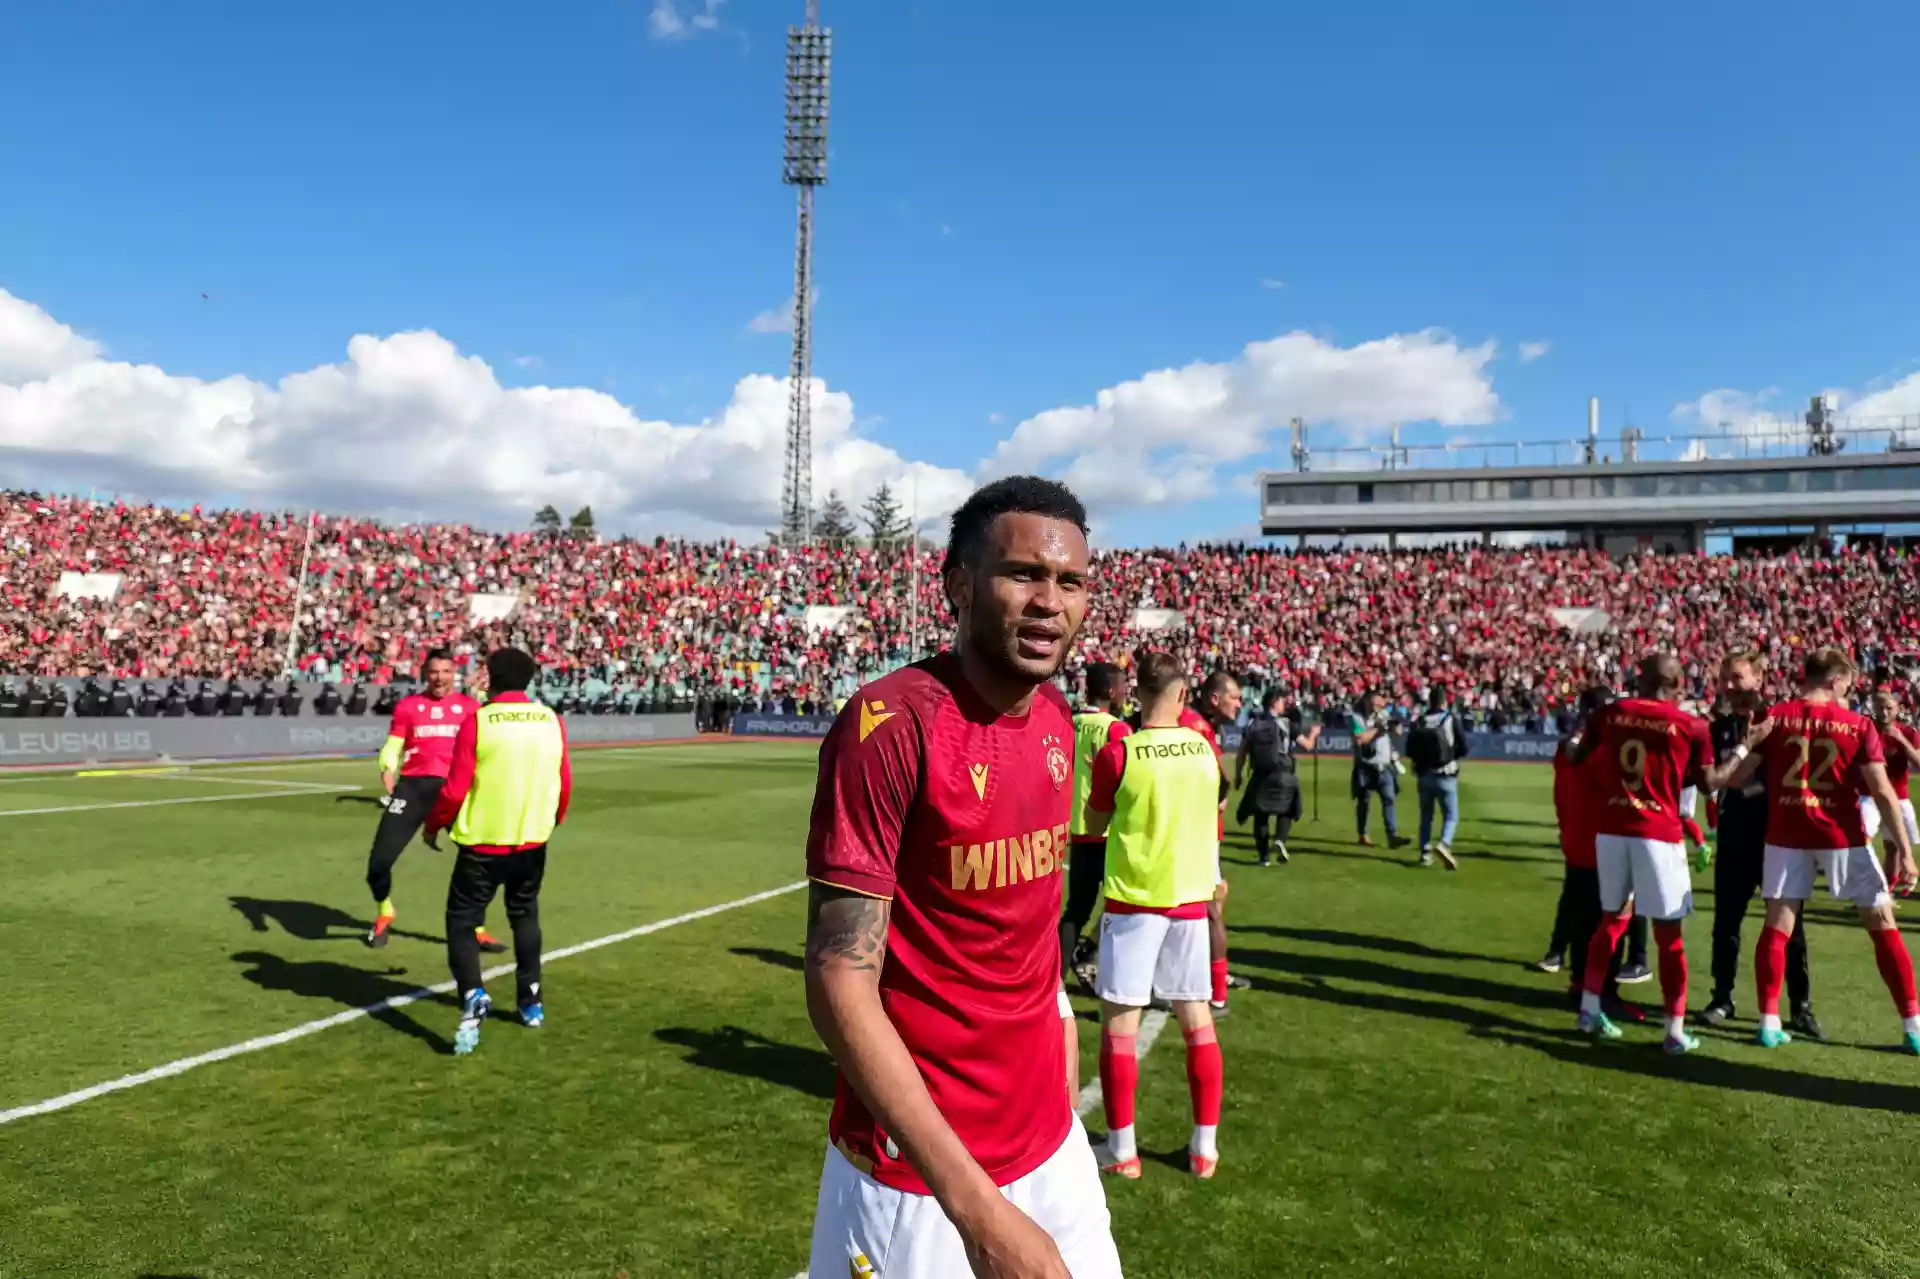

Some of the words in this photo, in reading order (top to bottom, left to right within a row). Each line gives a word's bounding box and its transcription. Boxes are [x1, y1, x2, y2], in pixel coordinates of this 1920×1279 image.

[1135, 741, 1210, 760] macron
[1619, 739, 1647, 792] 9
[1782, 735, 1838, 791] 22
[950, 820, 1070, 891] WINBE
